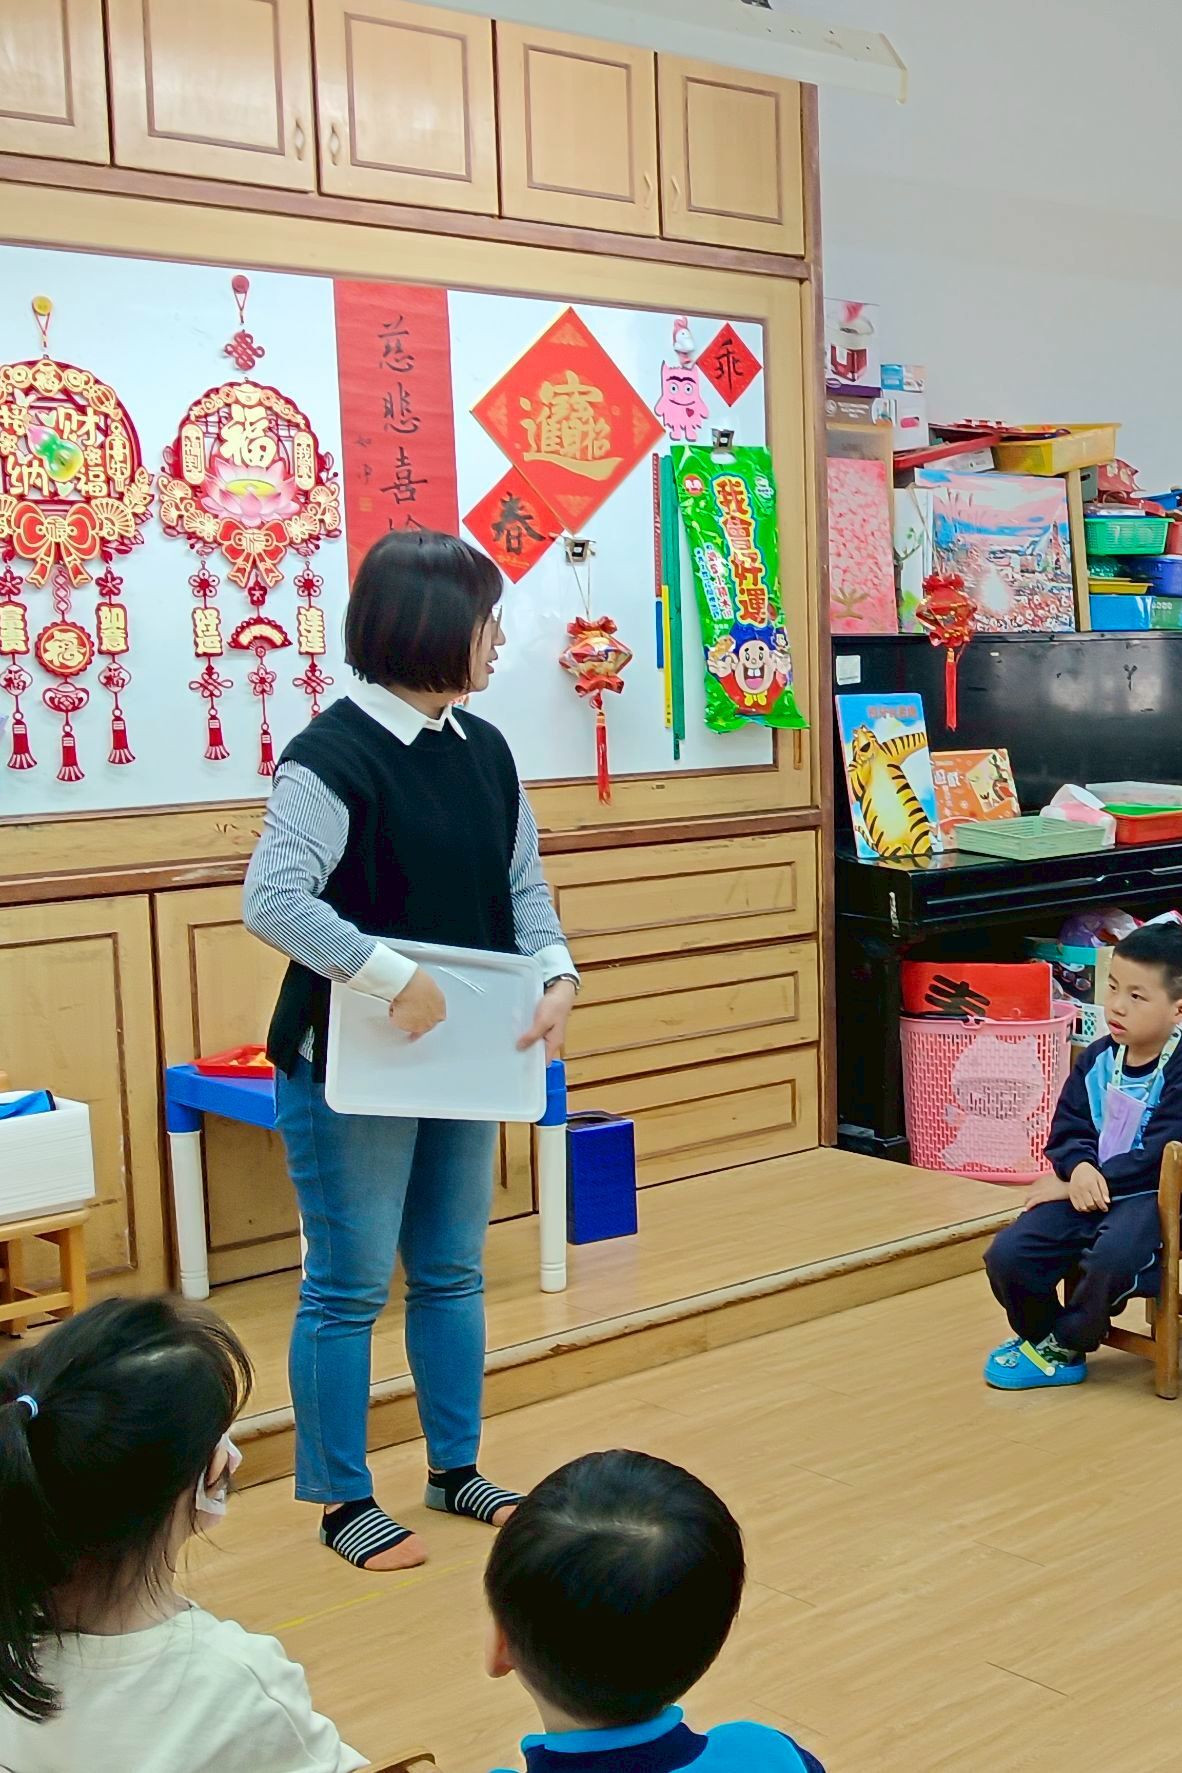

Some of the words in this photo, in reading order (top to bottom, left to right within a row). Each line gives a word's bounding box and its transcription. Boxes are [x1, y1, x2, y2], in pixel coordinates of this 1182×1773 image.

[714, 338, 744, 396] 乖
[219, 403, 277, 469] 福
[491, 491, 546, 555] 春
